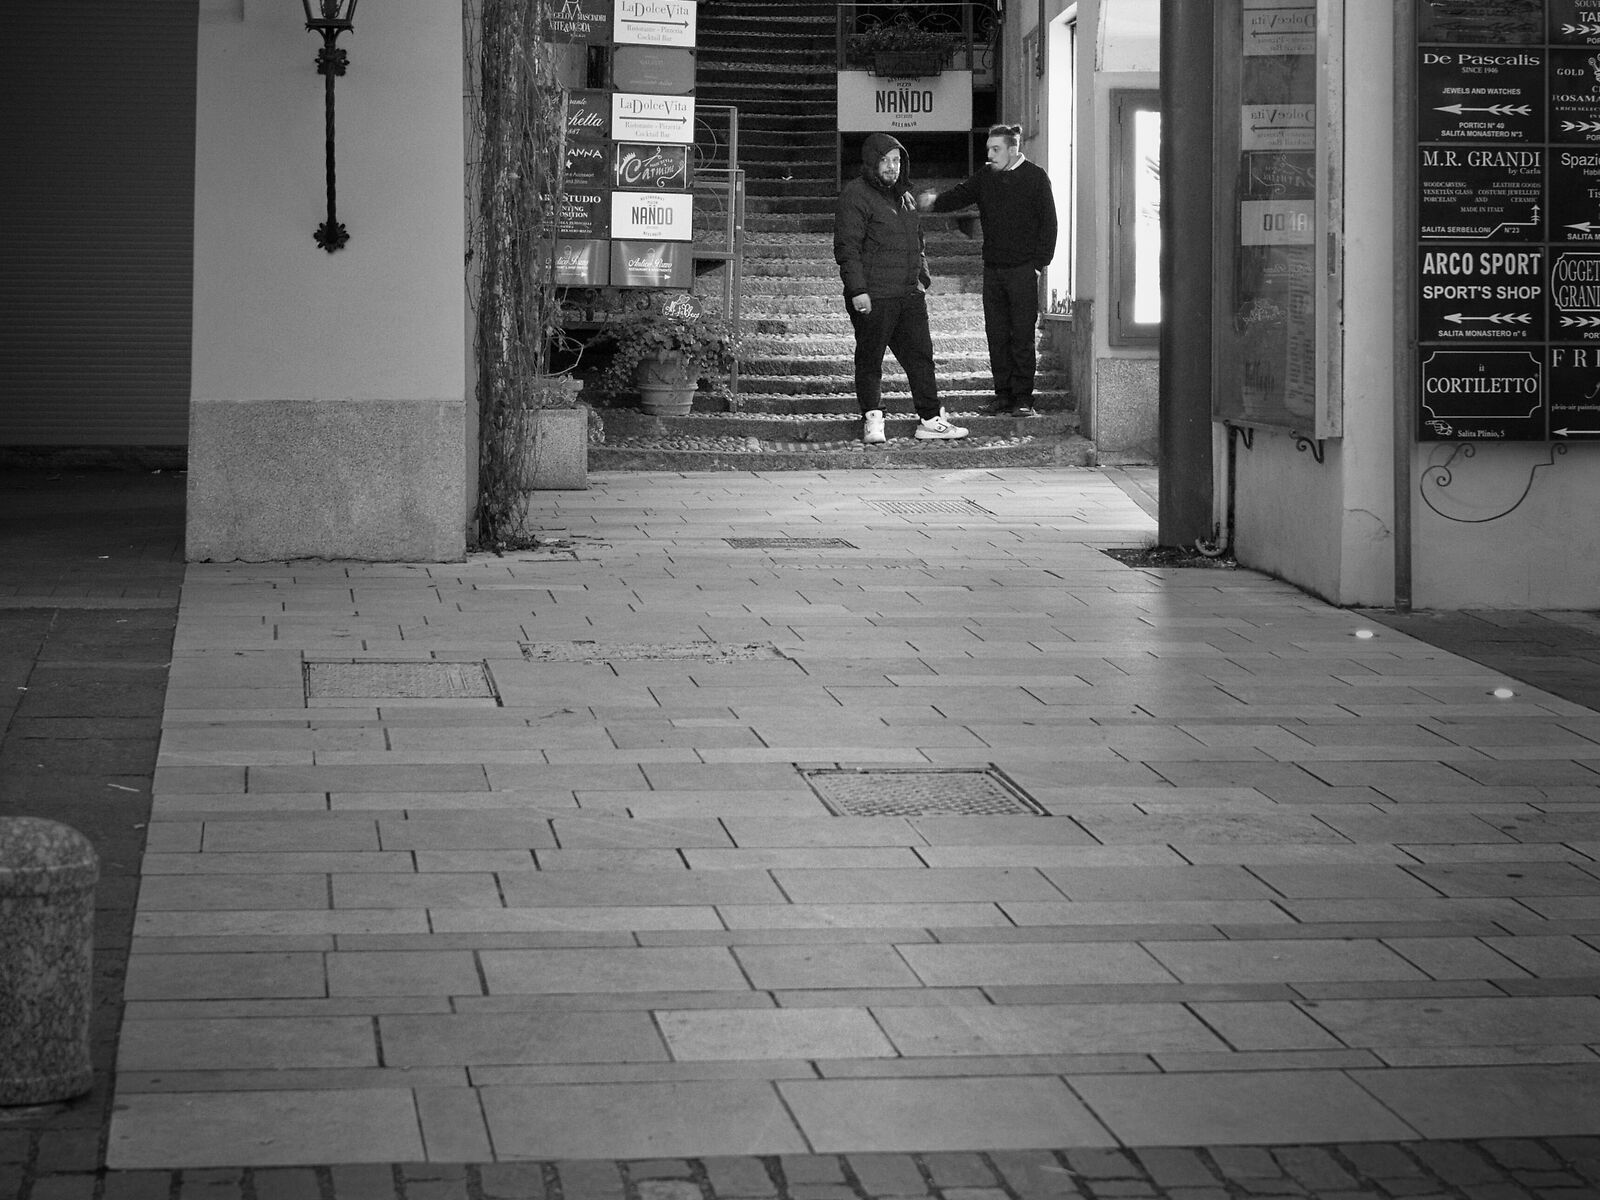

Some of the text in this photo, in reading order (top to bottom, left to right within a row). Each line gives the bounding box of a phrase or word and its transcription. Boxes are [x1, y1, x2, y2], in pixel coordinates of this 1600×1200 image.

[1423, 53, 1540, 66] De Pascalis
[1556, 68, 1585, 76] GOLD
[1442, 87, 1470, 95] JEWELS
[568, 148, 603, 159] ANNA
[1423, 150, 1541, 167] M.R. GRANDI
[1508, 167, 1518, 175] by
[1422, 252, 1541, 275] ARCO SPORT
[1423, 285, 1541, 300] SPORT'S SHOP
[1426, 377, 1537, 394] CORTILETTO
[1457, 429, 1476, 437] Salita
